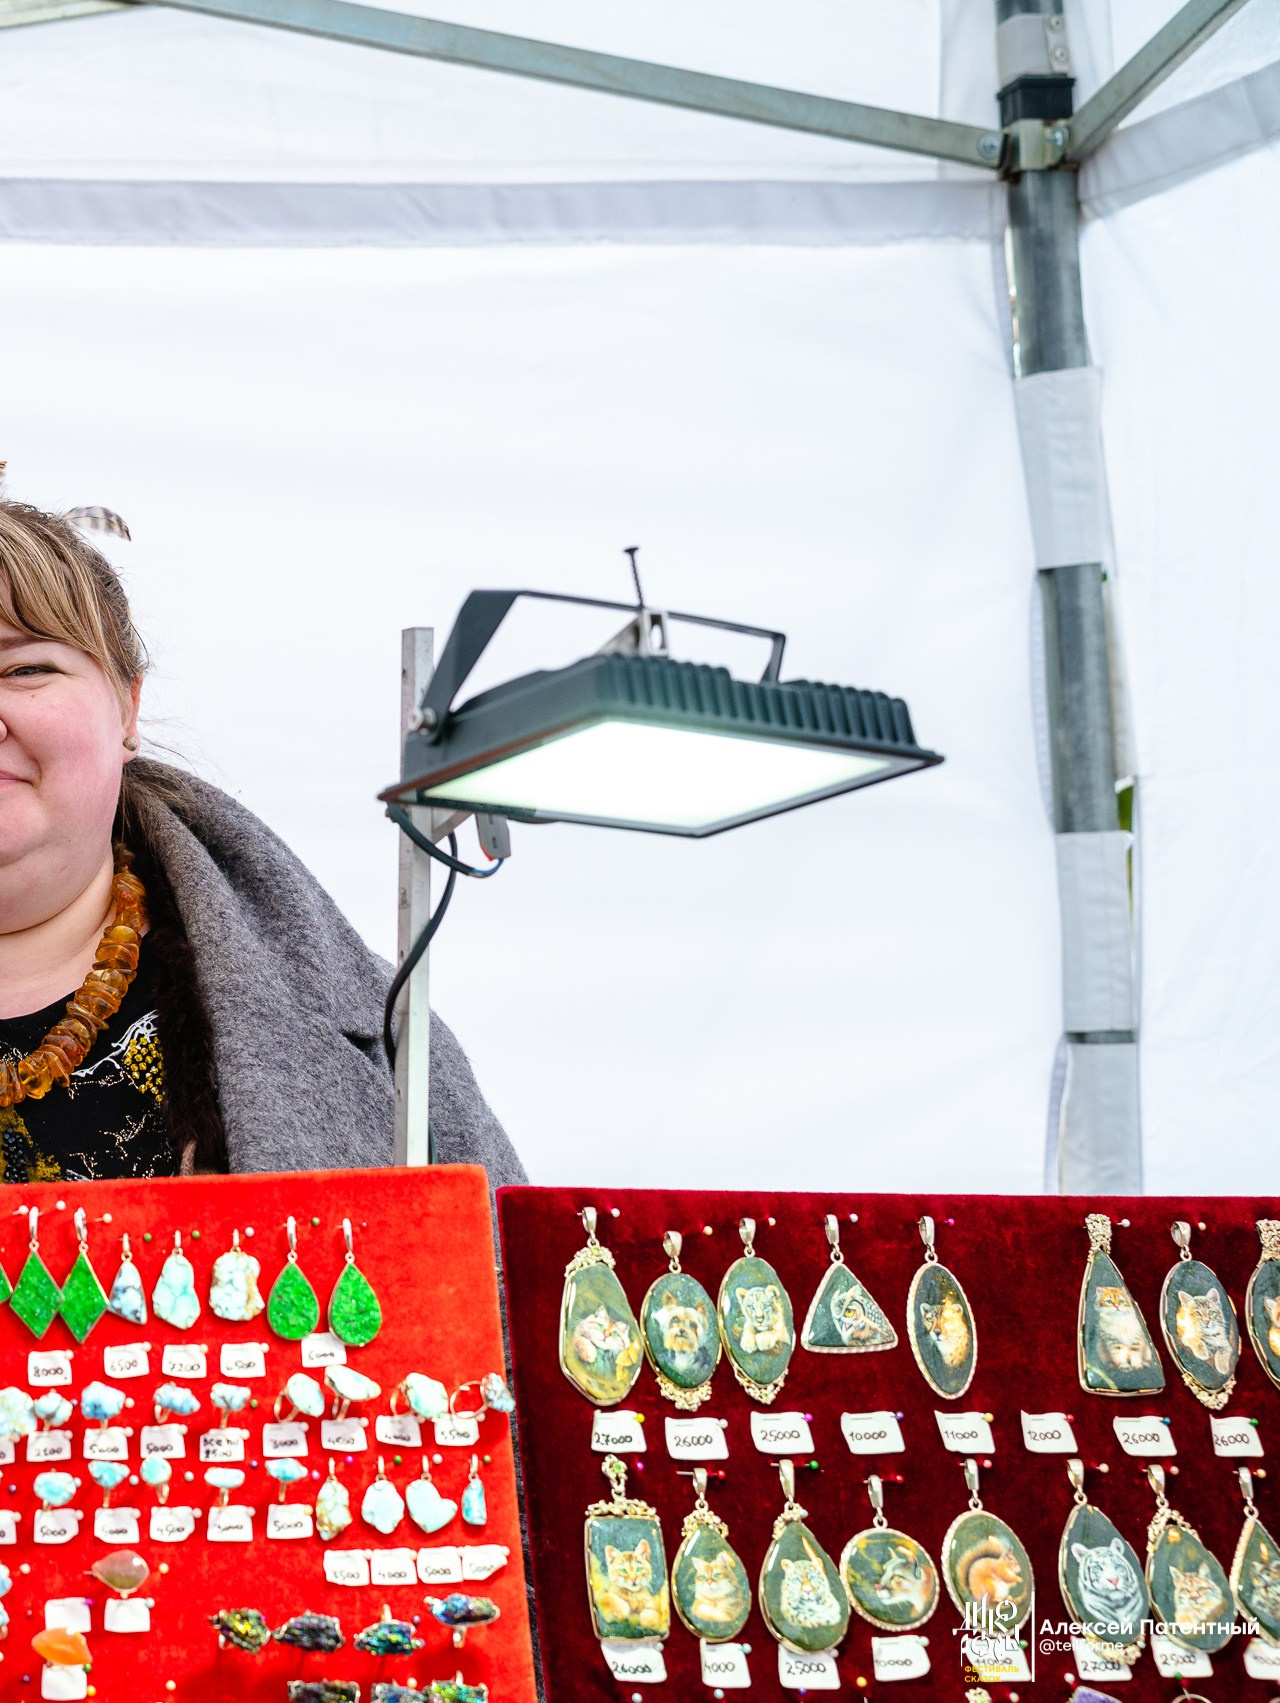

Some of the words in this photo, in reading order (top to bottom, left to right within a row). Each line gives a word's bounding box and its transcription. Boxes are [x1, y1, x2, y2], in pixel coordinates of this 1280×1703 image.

[33, 1366, 64, 1378] 8000
[593, 1431, 633, 1445] 27000
[674, 1434, 713, 1448] 26000
[760, 1429, 801, 1442] 25000
[848, 1430, 888, 1442] 10000
[944, 1430, 978, 1441] 11000
[1027, 1429, 1062, 1441] 12000
[1122, 1432, 1160, 1445] 26000
[1214, 1433, 1250, 1447] 26000
[874, 1658, 913, 1668] 10000
[1160, 1654, 1197, 1666] 25000
[785, 1661, 827, 1675] 25000
[1080, 1660, 1121, 1674] 27000
